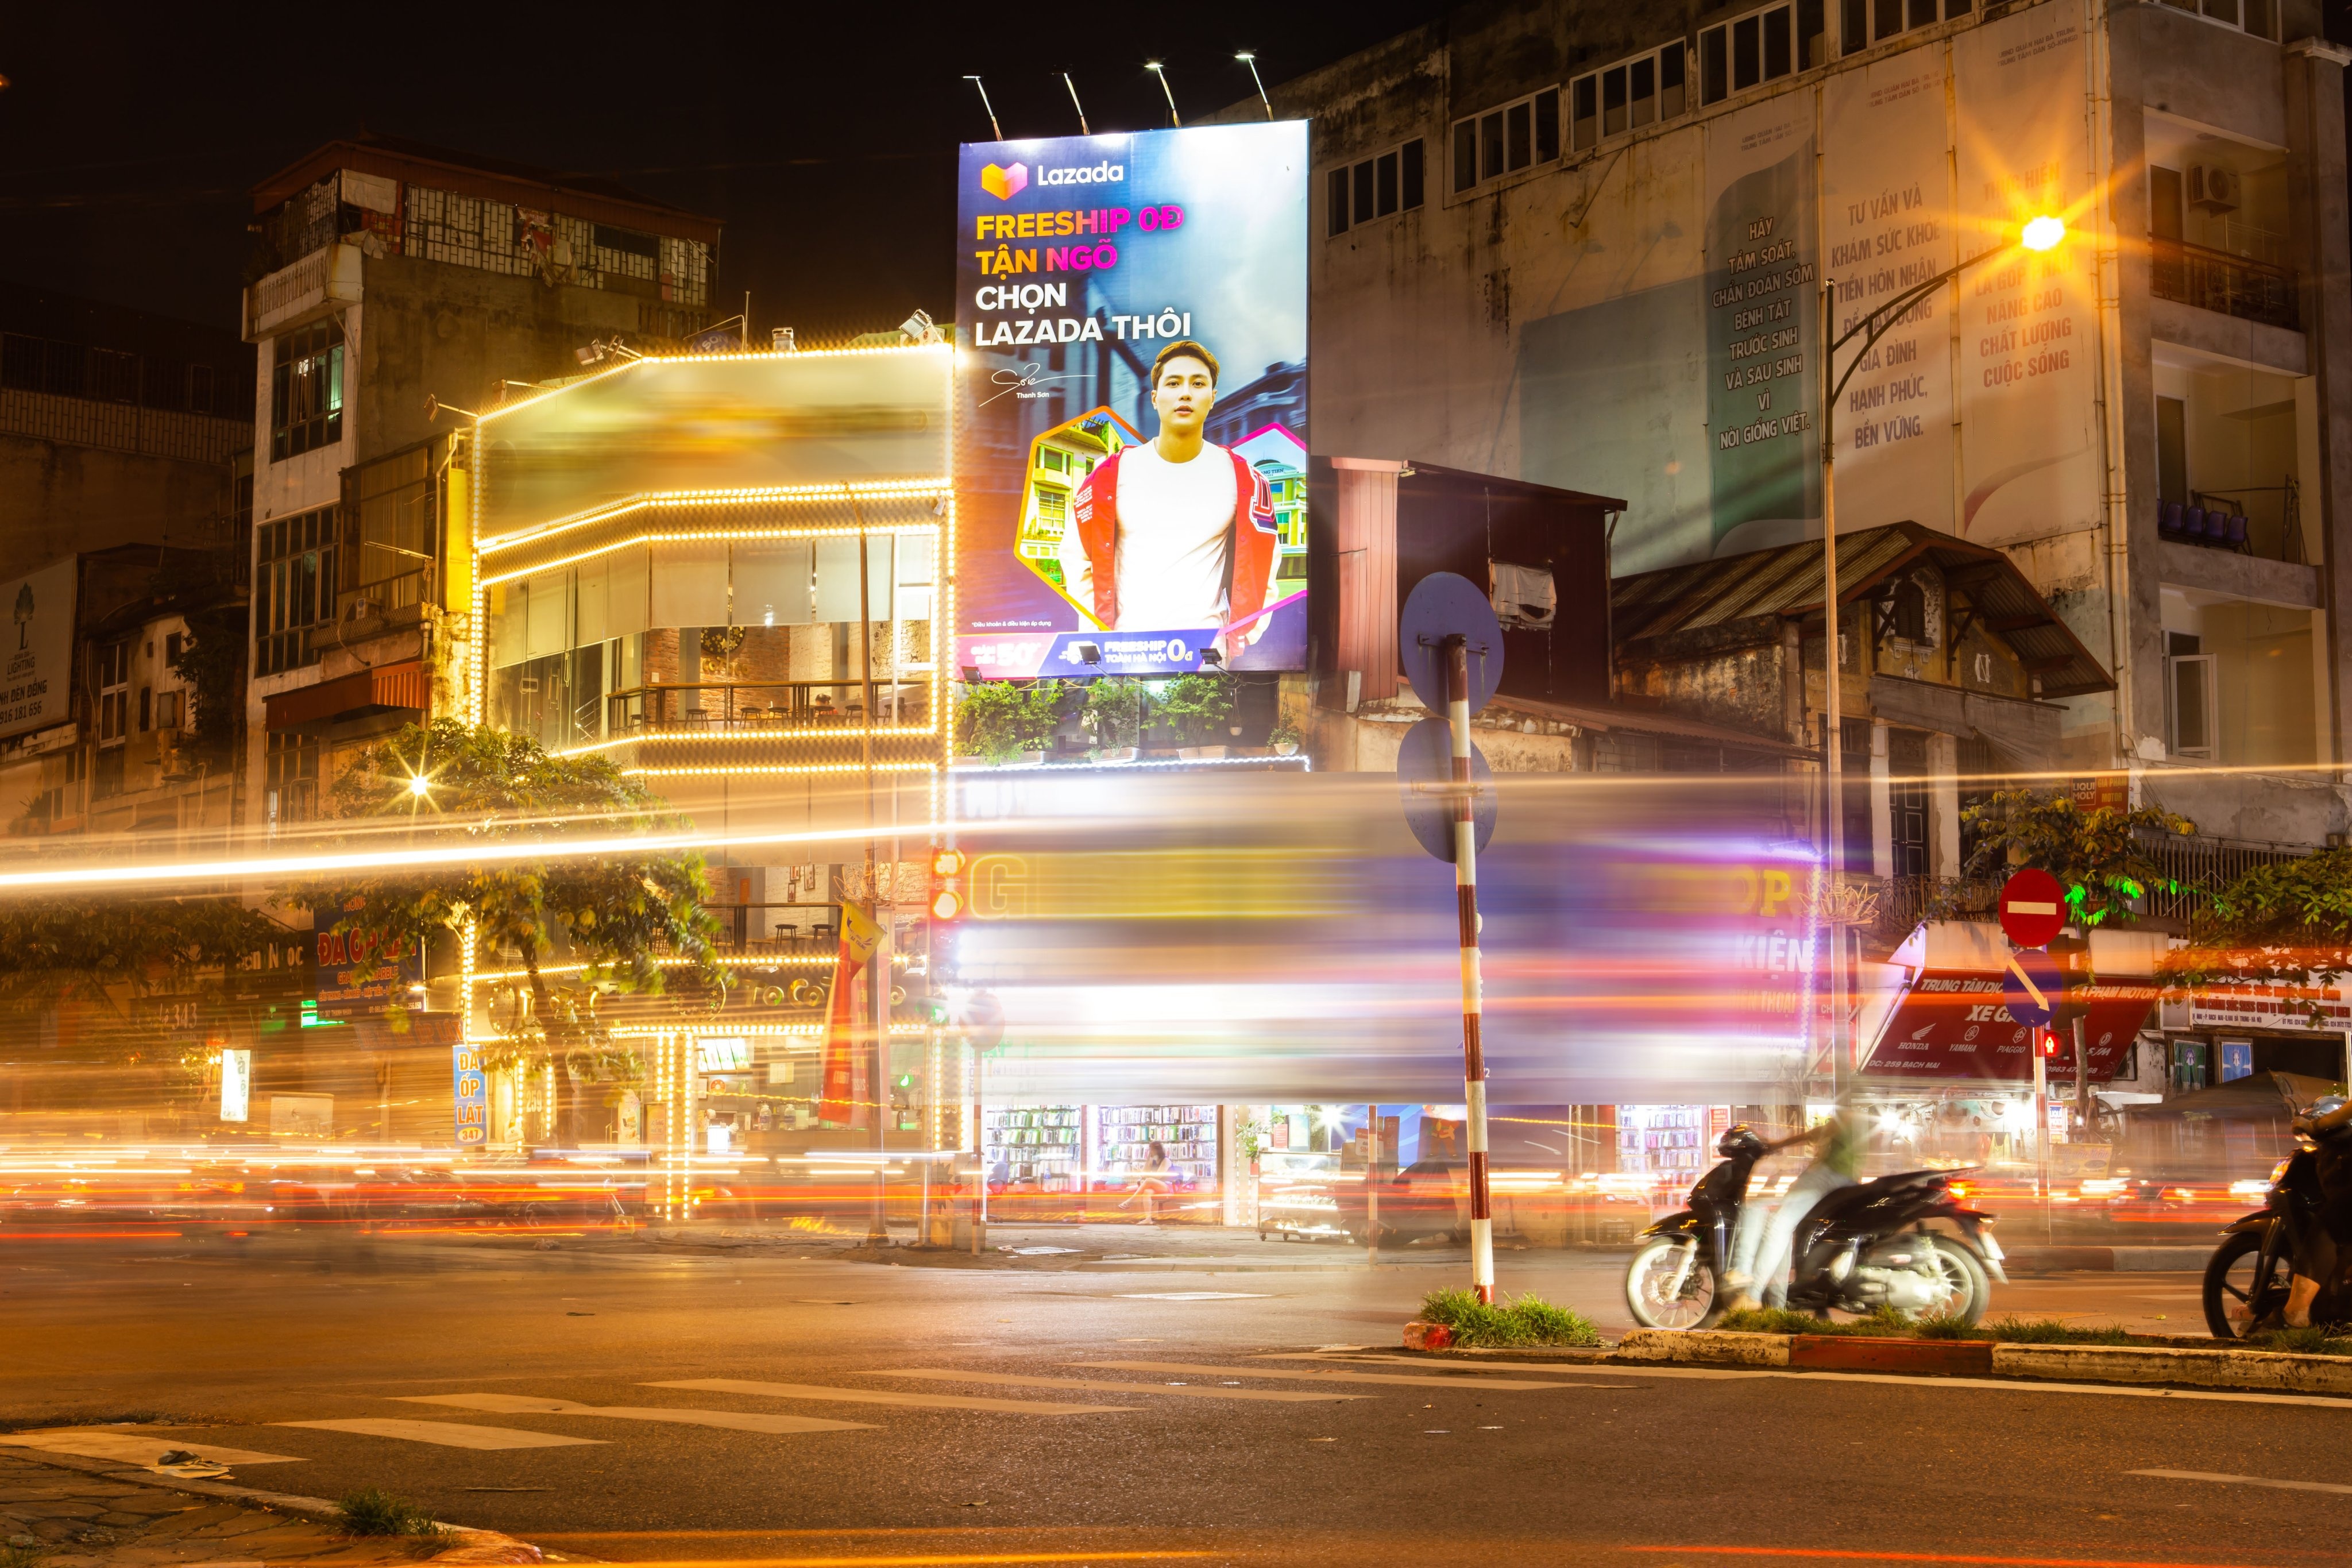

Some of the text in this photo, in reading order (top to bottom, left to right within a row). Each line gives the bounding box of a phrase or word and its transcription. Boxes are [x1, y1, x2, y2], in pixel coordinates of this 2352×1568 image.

[1037, 160, 1123, 186] Lazada
[1848, 181, 1922, 226] TƯ VẤN VÀ
[976, 204, 1184, 240] FREESHIP 0Đ
[1749, 217, 1774, 241] HÃY
[1832, 214, 1940, 268] KHÁM SỨC KHỎE
[976, 239, 1118, 280] TẬN NGÕ
[1728, 239, 1795, 275] TẦM SOÁT,
[1712, 263, 1814, 308] CHẨN ĐOÁN SỚM
[1837, 256, 1936, 303] TIỀN HÔN NHÂN
[976, 282, 1067, 315] CHỌN
[1987, 287, 2063, 325] NÂNG CAO
[976, 307, 1191, 346] LAZADA THÔI
[1735, 299, 1791, 333] BỆNH TẬT
[1729, 326, 1798, 361] TRƯỚC SINH
[1980, 317, 2072, 358] CHẤT LƯỢNG
[1860, 339, 1917, 372] GIA ĐÌNH
[1984, 347, 2069, 388] CUỘC SỐNG
[1725, 354, 1802, 391] VÀ SAU SINH
[1757, 388, 1770, 411] VÌ
[1850, 373, 1928, 415] HẠNH PHÚC,
[1720, 411, 1810, 450] NÒI GIỐNG VIỆT.
[1855, 415, 1924, 449] BỀN VỮNG.
[1104, 640, 1167, 652] FREESHIP
[1105, 651, 1167, 663] TOÀN HÀ NỘI
[7, 656, 35, 675] LIGHTING
[11, 677, 47, 703] ĐÈN ĐỒNG
[15, 705, 26, 721] 181
[29, 701, 42, 717] 656
[2073, 782, 2095, 791] LIQUI
[2073, 791, 2122, 802] MOLY MOTOR
[1733, 929, 1812, 980] KIỆN
[1921, 979, 1961, 992] TRUNG
[1961, 978, 1986, 992] TÂM
[1985, 981, 2004, 996] DỊC
[2087, 986, 2121, 1000] PHẠM
[2121, 987, 2159, 999] MOTOR
[172, 1002, 197, 1030] 343
[1965, 1005, 1995, 1022] XE
[458, 1049, 480, 1071] ĐÁ
[1898, 1042, 2111, 1056] HONDA YAMAHA PIAGGIO SYM
[1902, 1061, 1925, 1069] BẠCH
[459, 1072, 480, 1098] ỐP
[457, 1102, 484, 1125] LÁT
[526, 1090, 542, 1113] 259
[462, 1129, 478, 1141] 347
